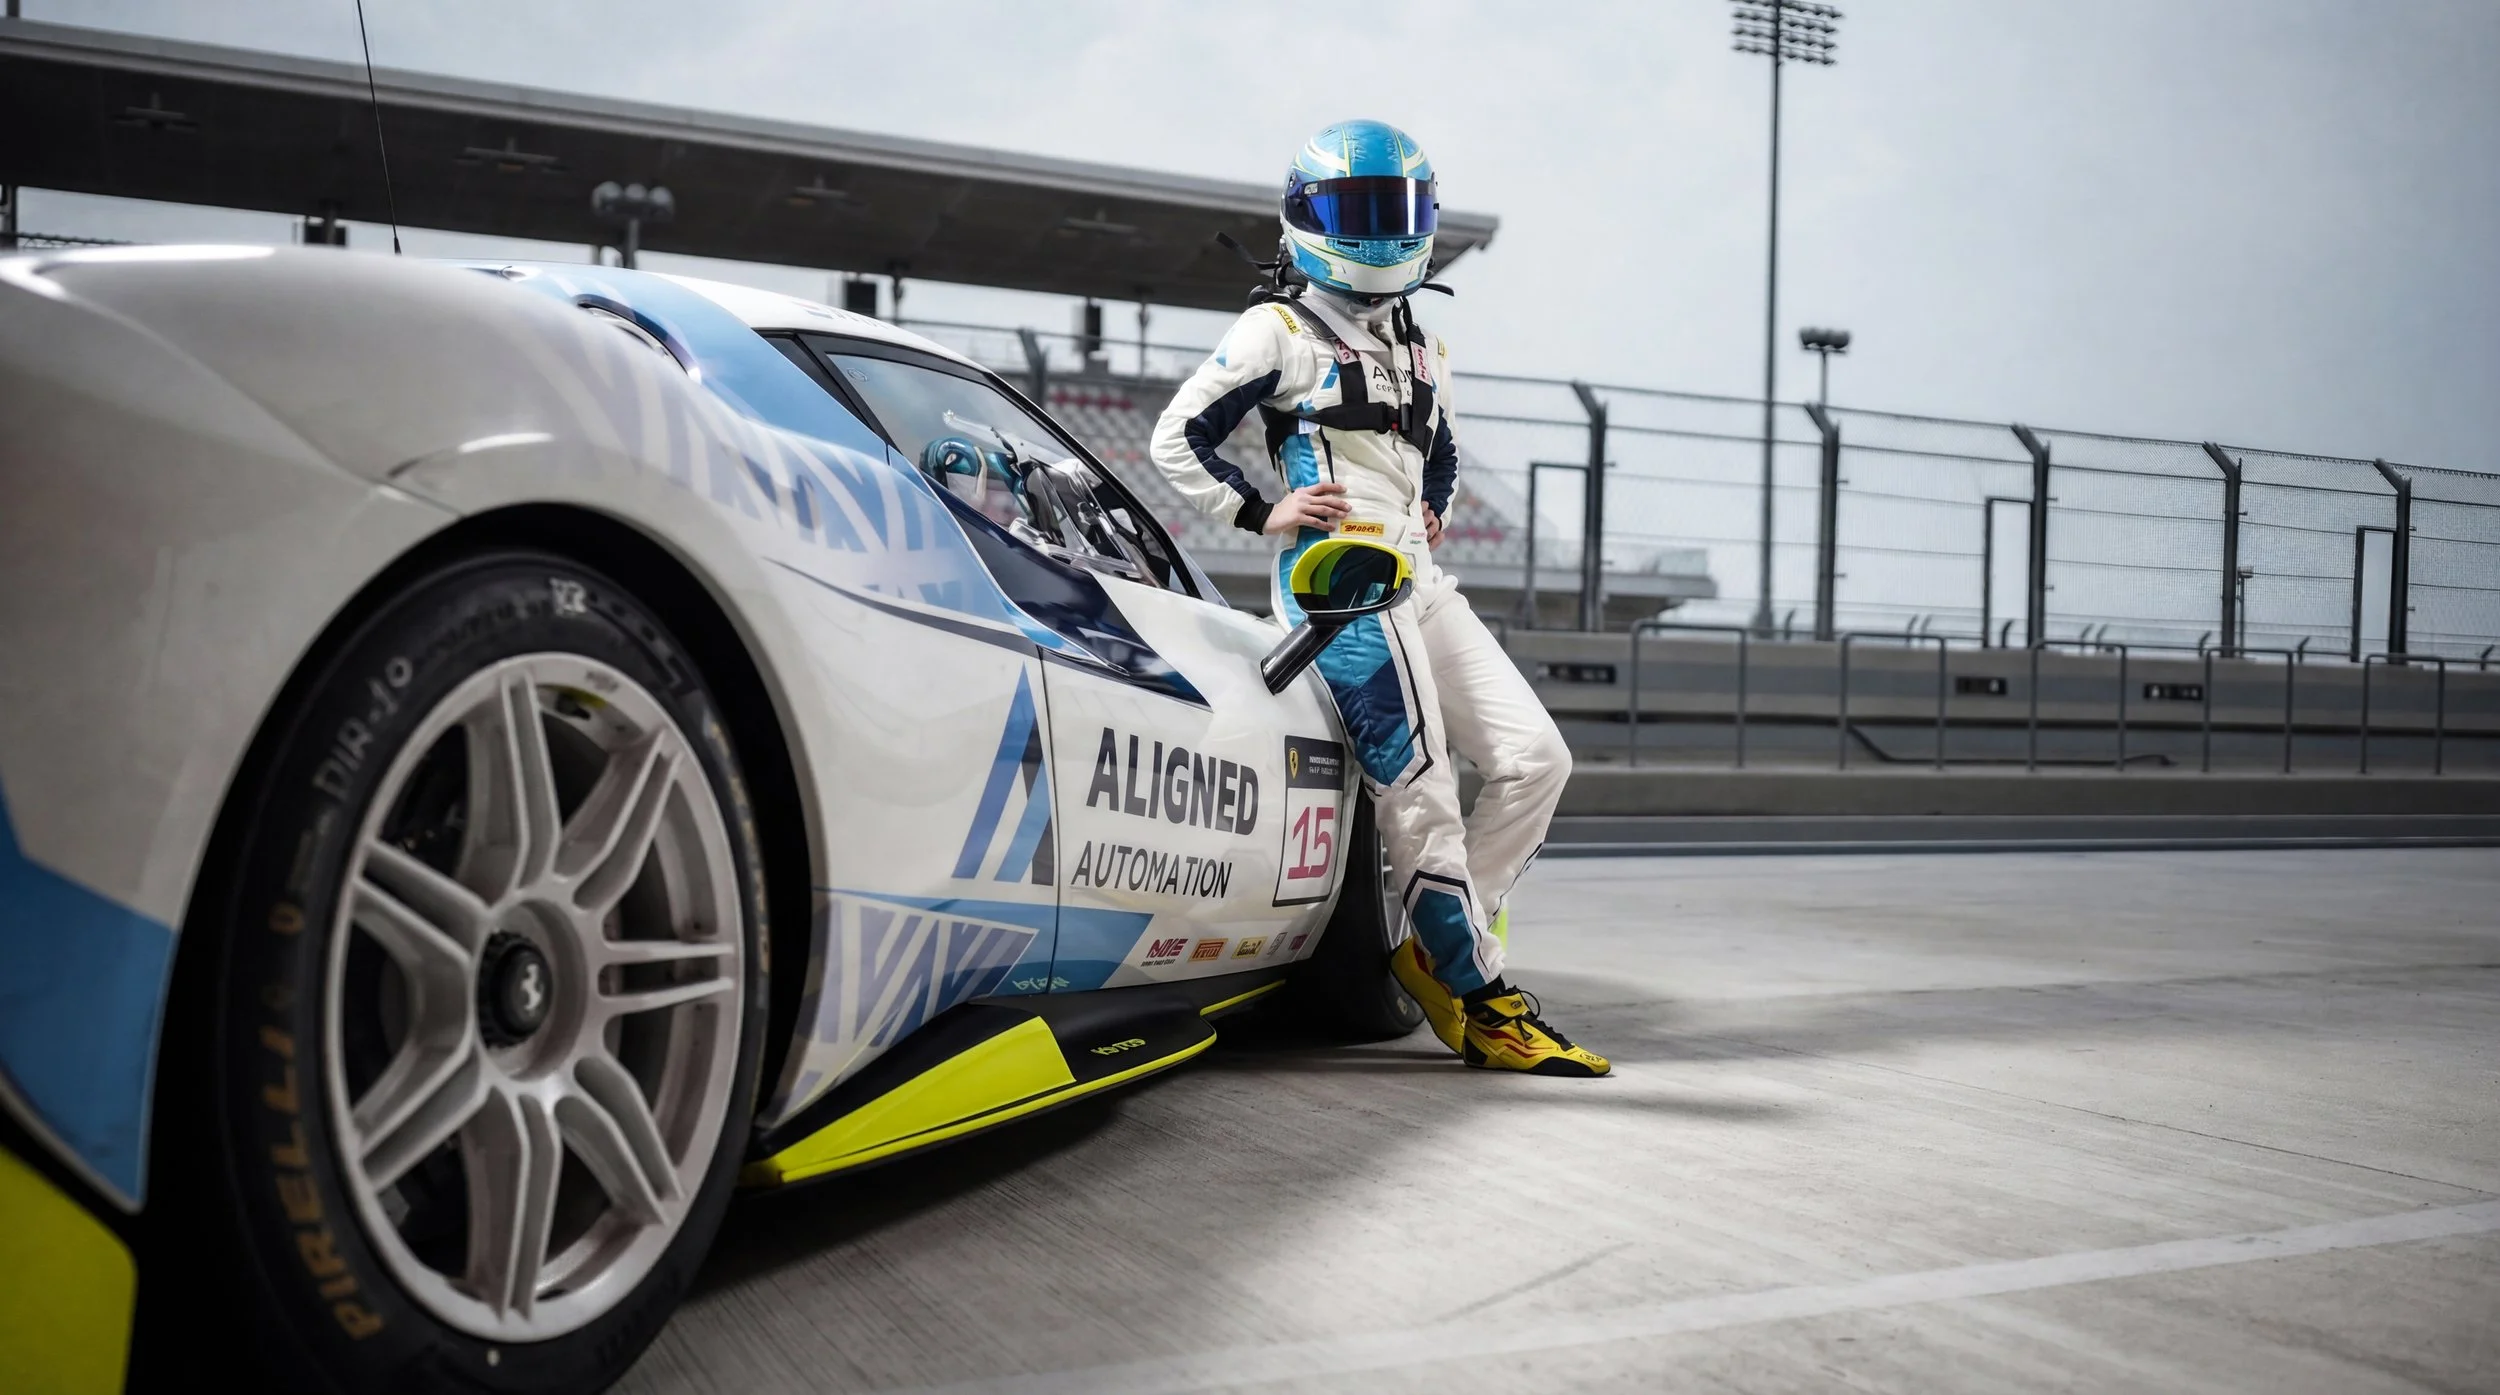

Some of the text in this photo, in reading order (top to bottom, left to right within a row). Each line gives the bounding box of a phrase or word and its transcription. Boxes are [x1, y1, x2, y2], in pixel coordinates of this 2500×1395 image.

[1086, 727, 1259, 836] ALIGNED
[1071, 840, 1233, 899] AUTOMATION
[1287, 806, 1335, 880] 15
[261, 1025, 385, 1342] PIRELLI
